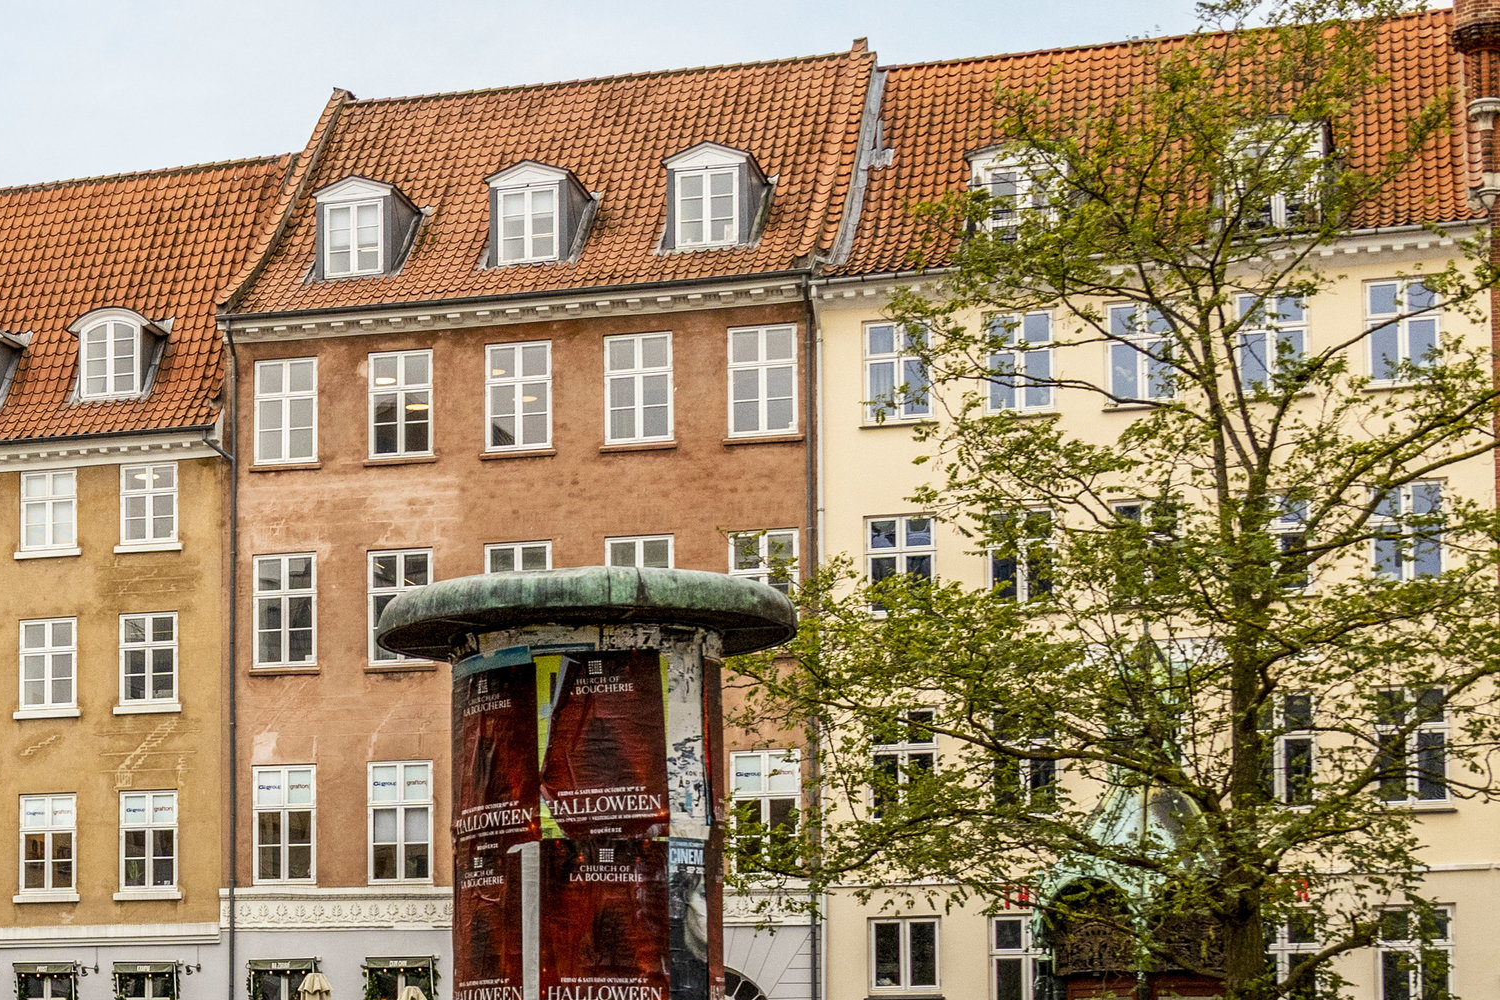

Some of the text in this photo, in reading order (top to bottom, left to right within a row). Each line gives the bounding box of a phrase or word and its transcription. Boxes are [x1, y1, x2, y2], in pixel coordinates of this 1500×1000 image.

[574, 675, 621, 685] HURCH OF
[457, 808, 533, 835] HALLOWEEN
[570, 873, 643, 882] LA BOUCHERIE
